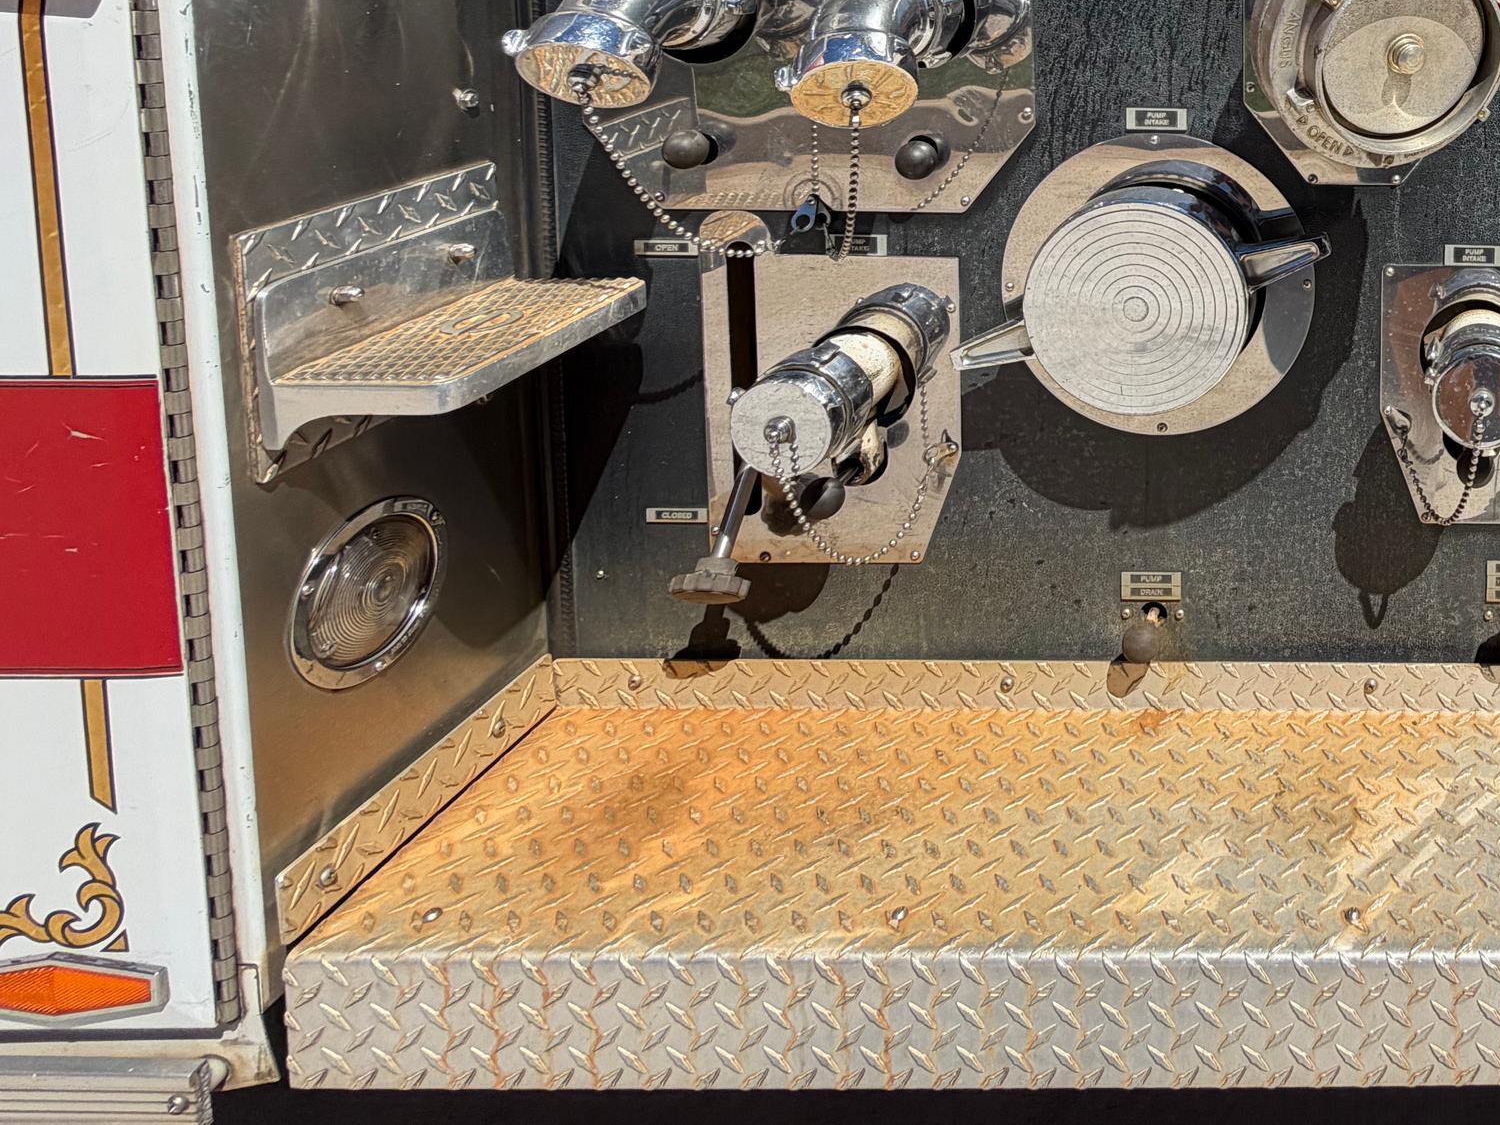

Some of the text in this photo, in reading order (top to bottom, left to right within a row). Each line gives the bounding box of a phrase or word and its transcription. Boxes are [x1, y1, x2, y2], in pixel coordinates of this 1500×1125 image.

[1279, 10, 1301, 69] ANGUS
[1306, 125, 1344, 155] OPEN
[655, 244, 679, 252] OPEN
[661, 511, 693, 519] CLOSED
